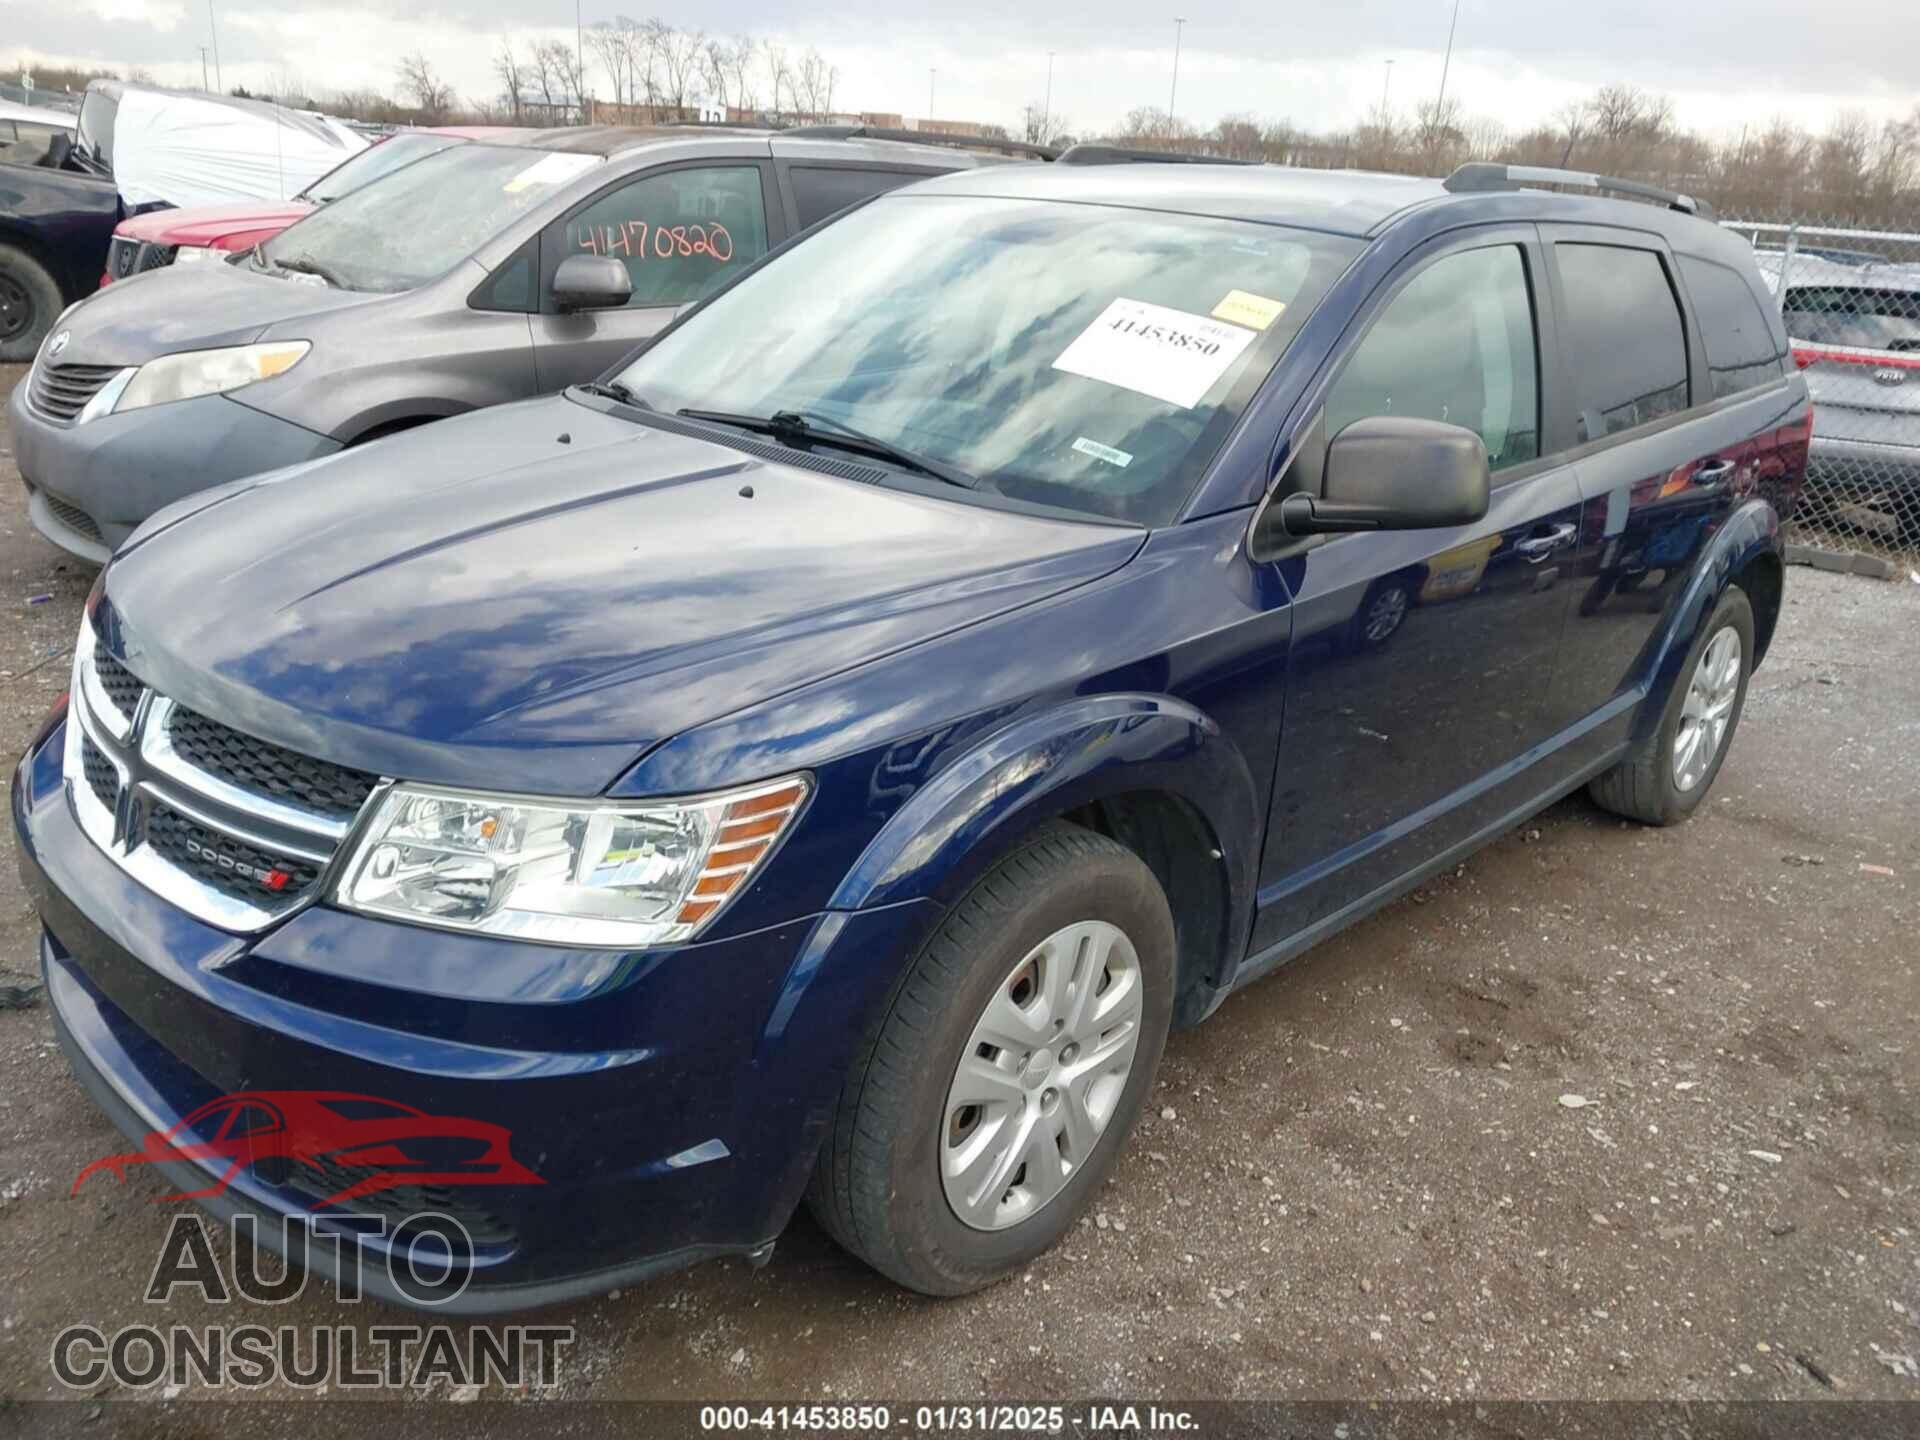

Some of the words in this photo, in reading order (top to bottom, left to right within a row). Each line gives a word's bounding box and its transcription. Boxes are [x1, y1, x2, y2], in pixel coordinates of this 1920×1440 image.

[577, 220, 733, 261] 41470820
[1107, 318, 1221, 356] 41453850
[187, 839, 269, 882] DODGE
